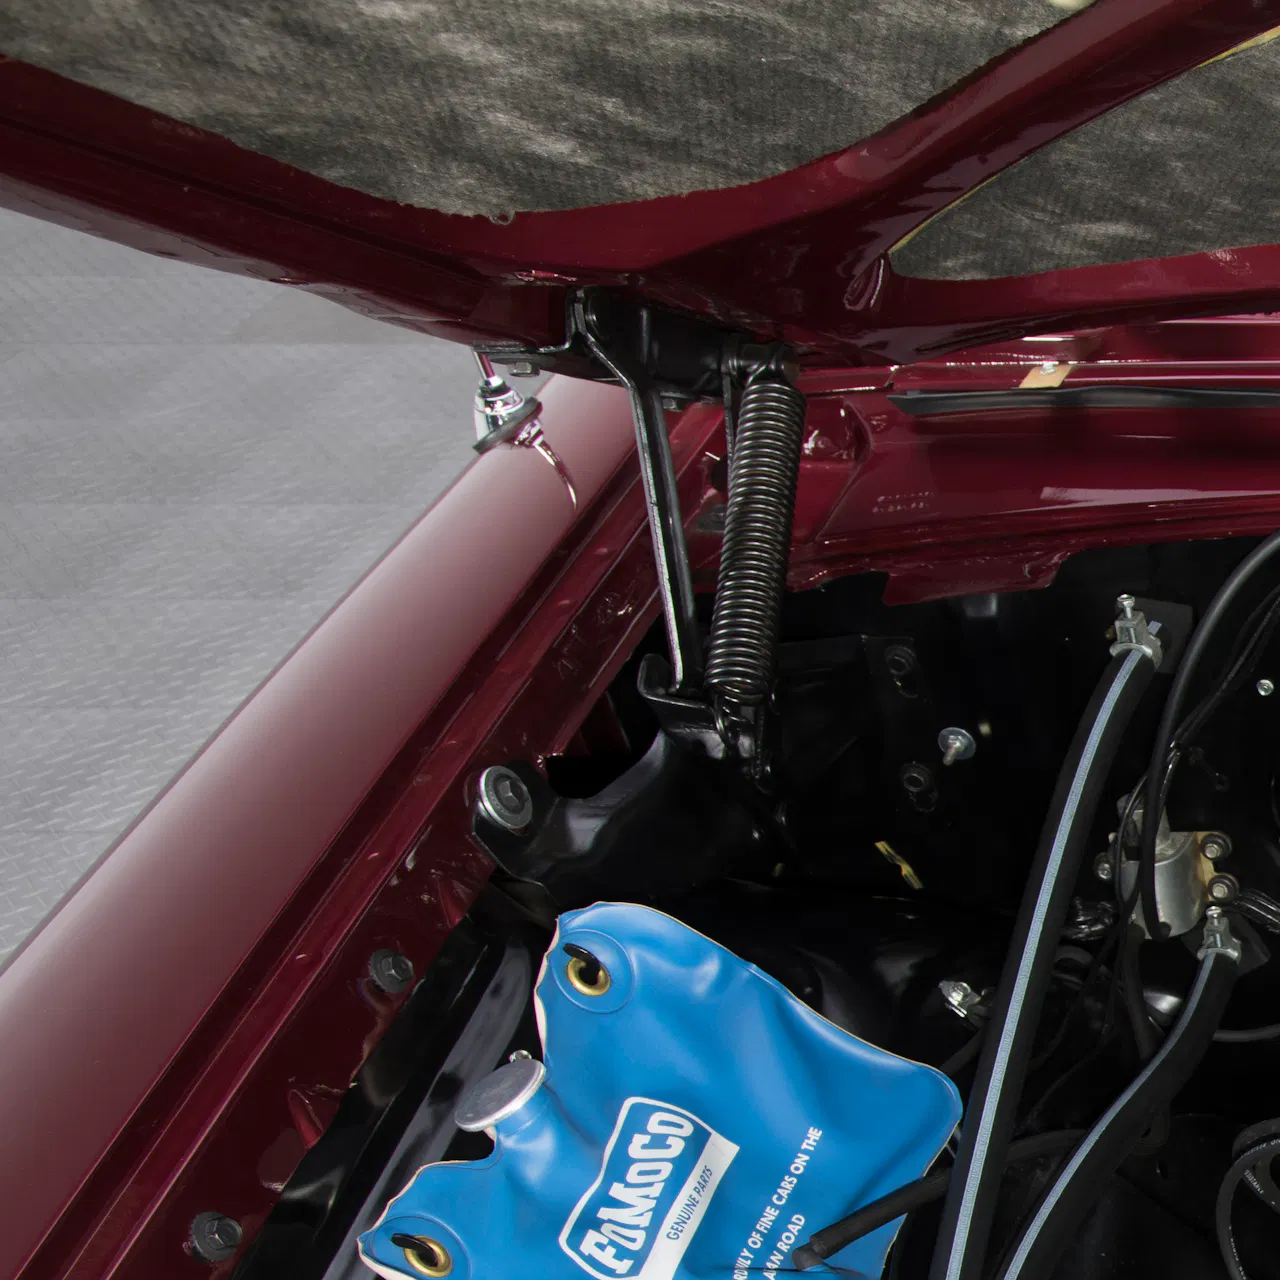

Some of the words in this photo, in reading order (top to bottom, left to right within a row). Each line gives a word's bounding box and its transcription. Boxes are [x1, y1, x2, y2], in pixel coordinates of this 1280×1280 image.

[666, 1195, 699, 1241] GENUINE
[694, 1165, 713, 1199] PARTS
[748, 1231, 764, 1249] OF
[756, 1205, 780, 1234] FINE
[771, 1174, 798, 1206] CARS
[790, 1153, 810, 1175] ON
[801, 1126, 823, 1153] THE
[777, 1213, 806, 1253] ROAD
